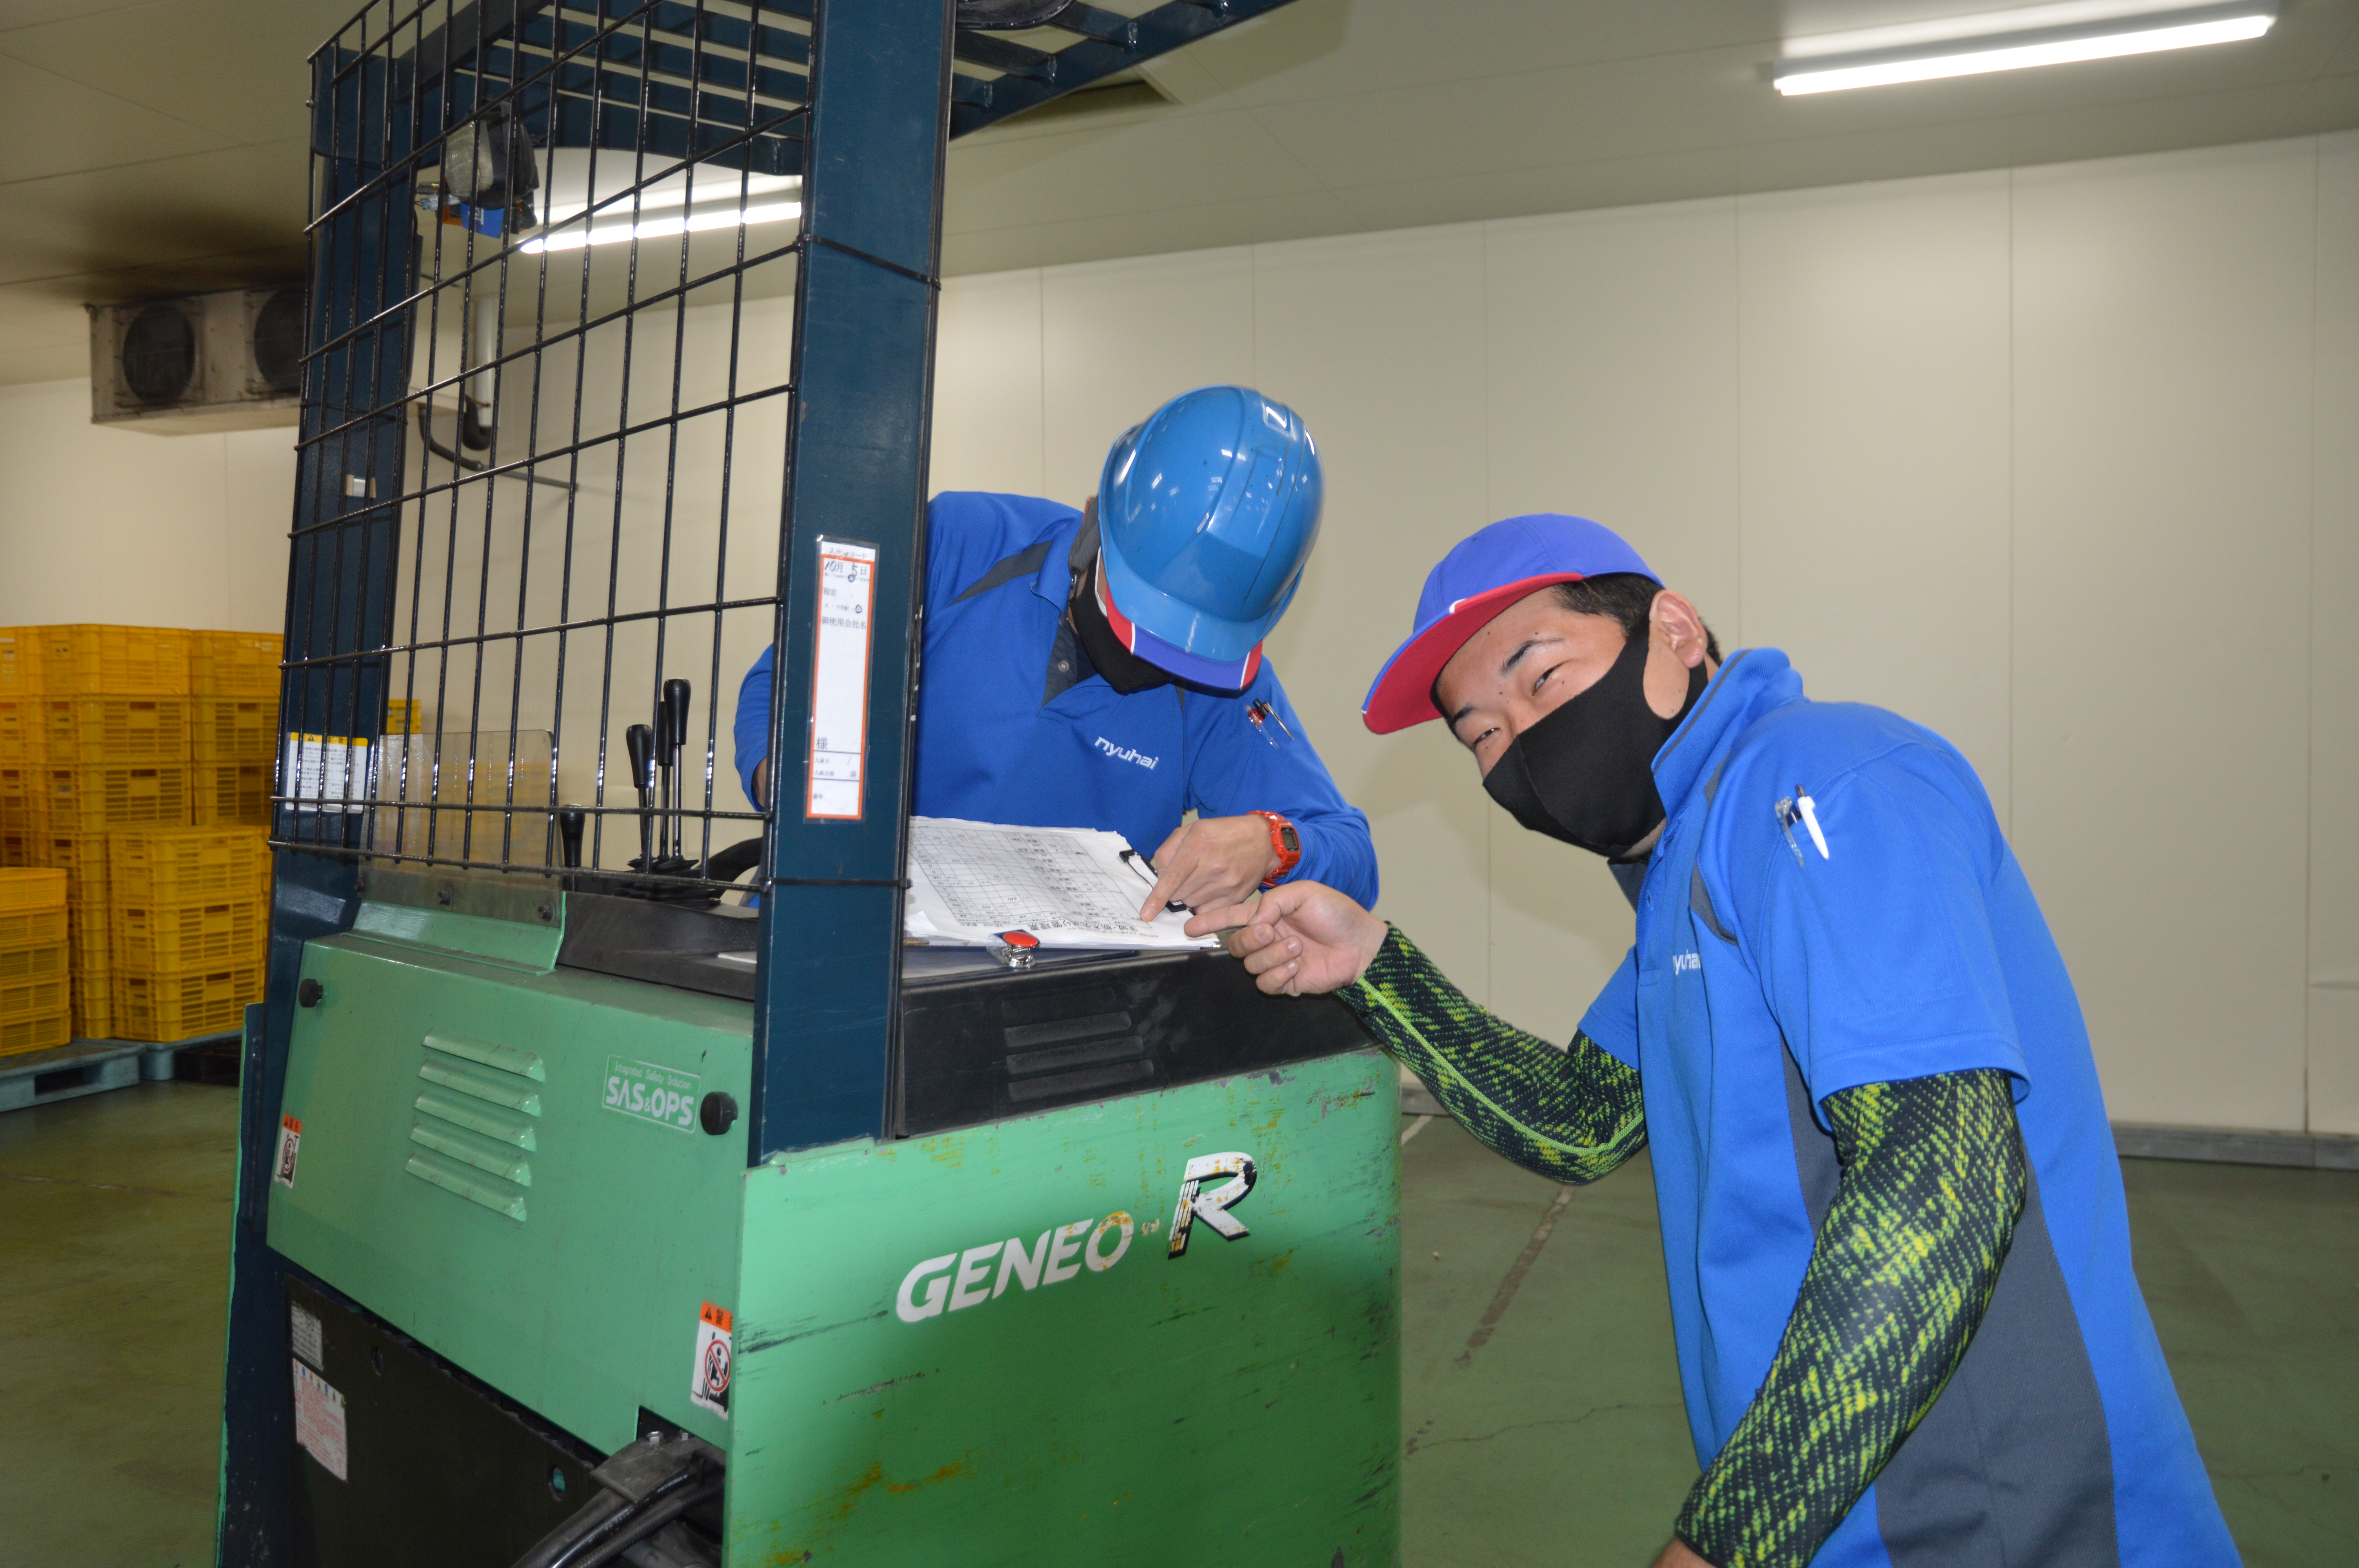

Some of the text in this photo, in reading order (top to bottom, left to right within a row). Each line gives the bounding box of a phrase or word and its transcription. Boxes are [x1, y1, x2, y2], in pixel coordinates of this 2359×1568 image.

[829, 548, 868, 559] 入出庫カード
[823, 587, 837, 596] 指定
[821, 616, 867, 629] 御使用会社名
[816, 736, 828, 750] 様
[615, 1061, 691, 1090] Integrated Safety Solution
[896, 1151, 1257, 1323] GENEO R
